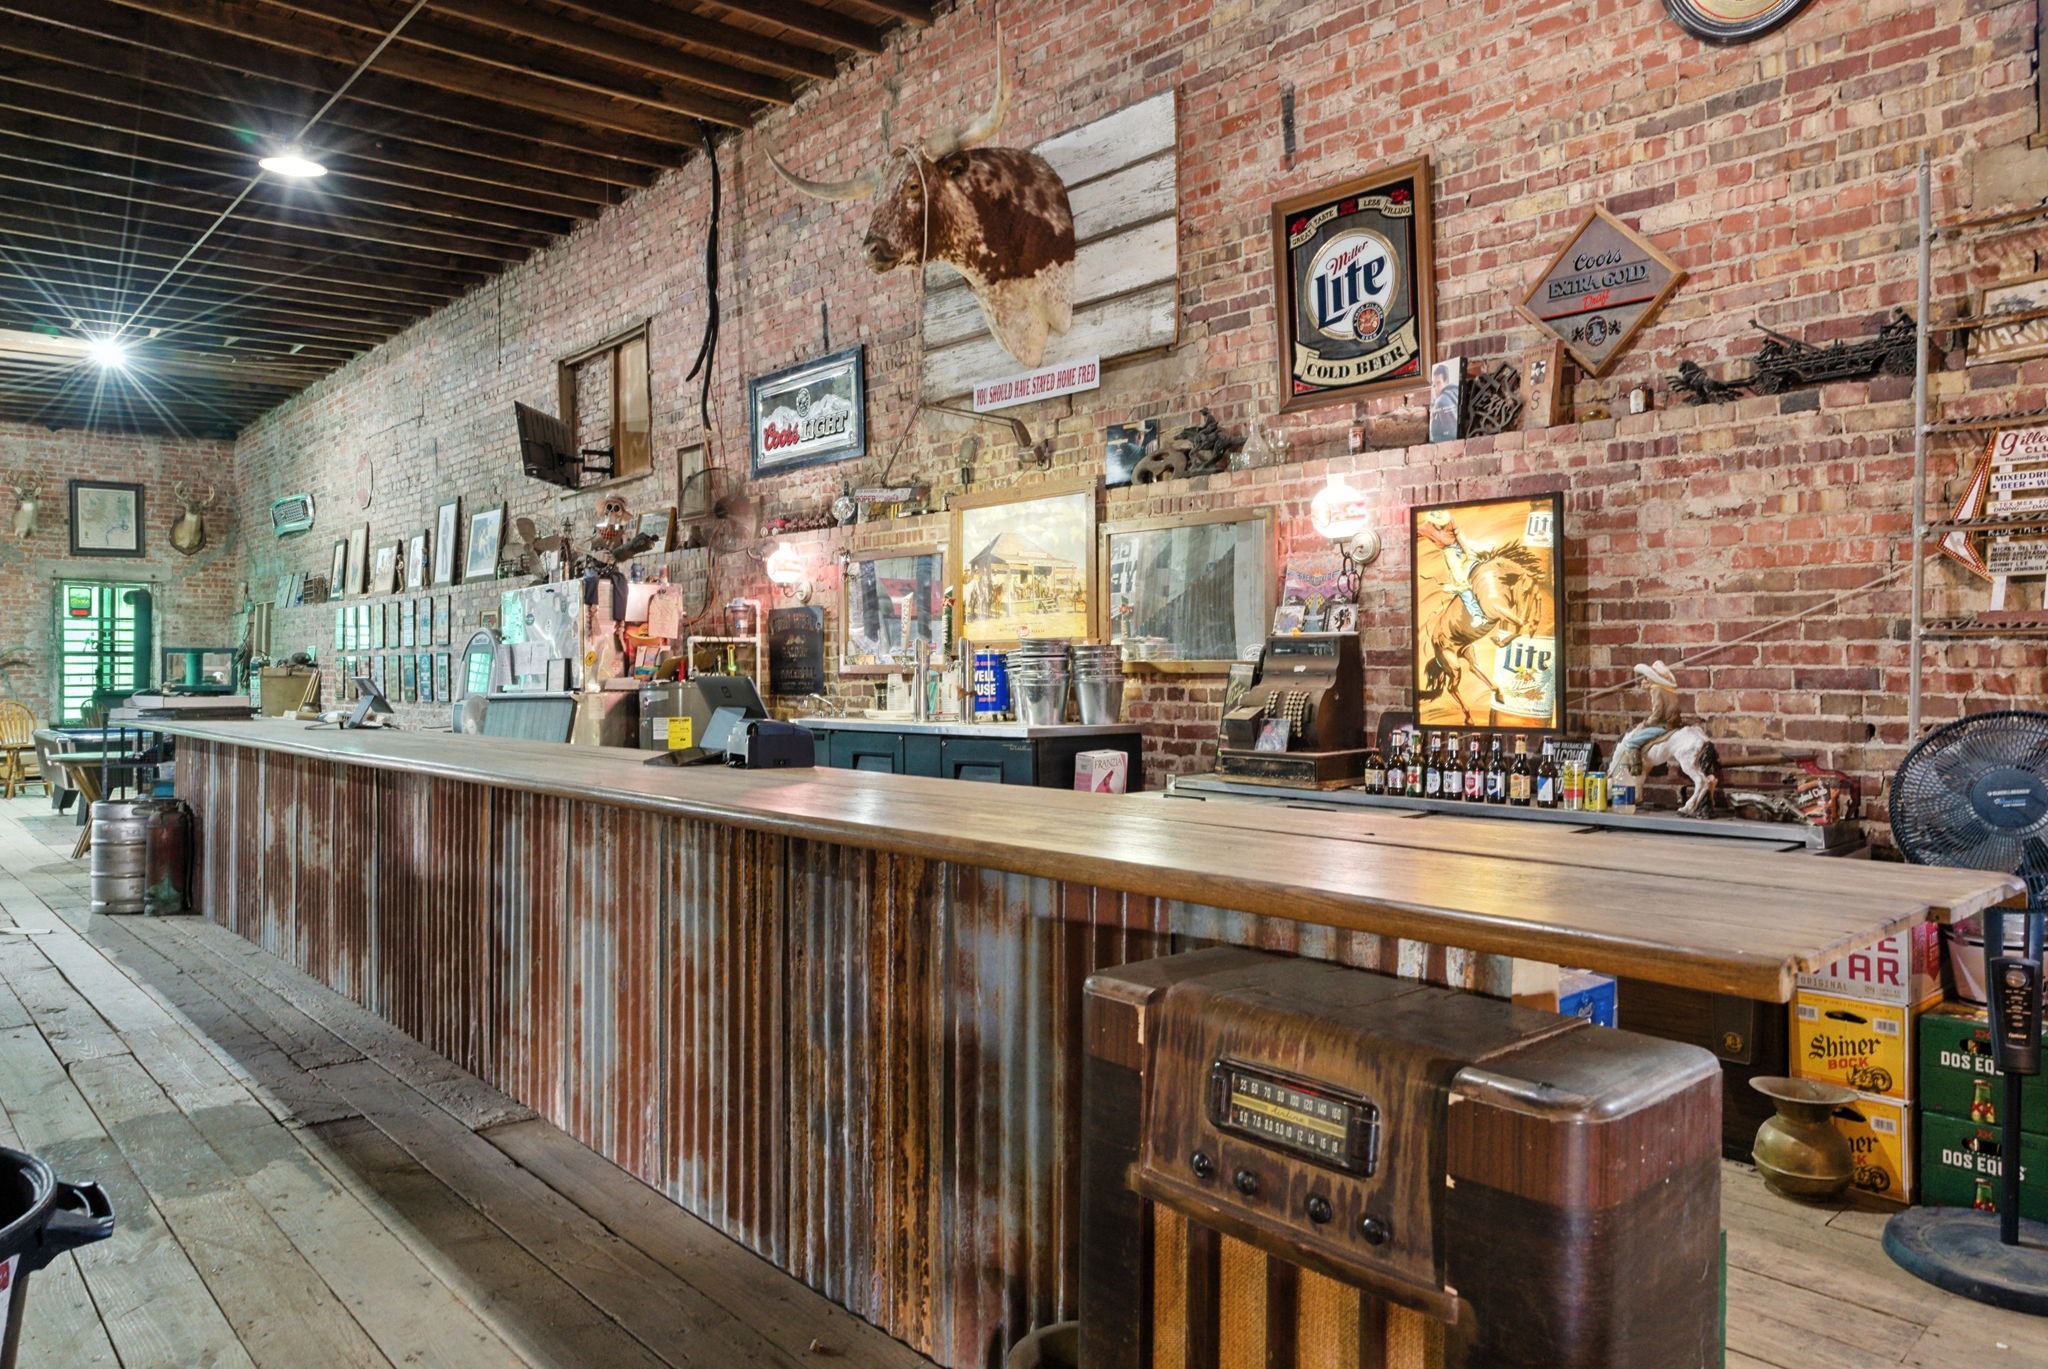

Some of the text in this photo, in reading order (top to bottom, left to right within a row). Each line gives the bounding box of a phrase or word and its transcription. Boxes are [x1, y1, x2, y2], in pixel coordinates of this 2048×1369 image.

[1292, 199, 1410, 246] GREAT TASTE LESS FILLING
[1326, 241, 1368, 275] Miller
[1574, 249, 1622, 272] Coors
[1315, 256, 1387, 329] Lite
[1549, 265, 1647, 299] EXTRA GOLD
[1583, 289, 1611, 311] Draft
[1306, 346, 1405, 379] COLD BEER
[976, 363, 1096, 407] YOU SHOULD HAVE STAYED HOME FRED
[764, 410, 848, 451] Coors LIGHT
[1995, 473, 2027, 482] MIXED
[2001, 481, 2026, 489] BEER
[1503, 643, 1551, 673] Lite
[1094, 758, 1123, 770] FRANZIA
[1800, 976, 1849, 991] ORIGINAL
[1809, 1034, 1881, 1059] Shiner
[1828, 1057, 1868, 1070] BOCK
[1941, 1051, 1970, 1069] DOS
[1264, 1086, 1271, 1098] 70
[1290, 1095, 1299, 1107] 100
[1303, 1098, 1313, 1111] 120
[1318, 1103, 1327, 1116] 140
[1297, 1130, 1303, 1142] 12
[1308, 1133, 1315, 1145] 14
[1943, 1149, 1973, 1169] DOS
